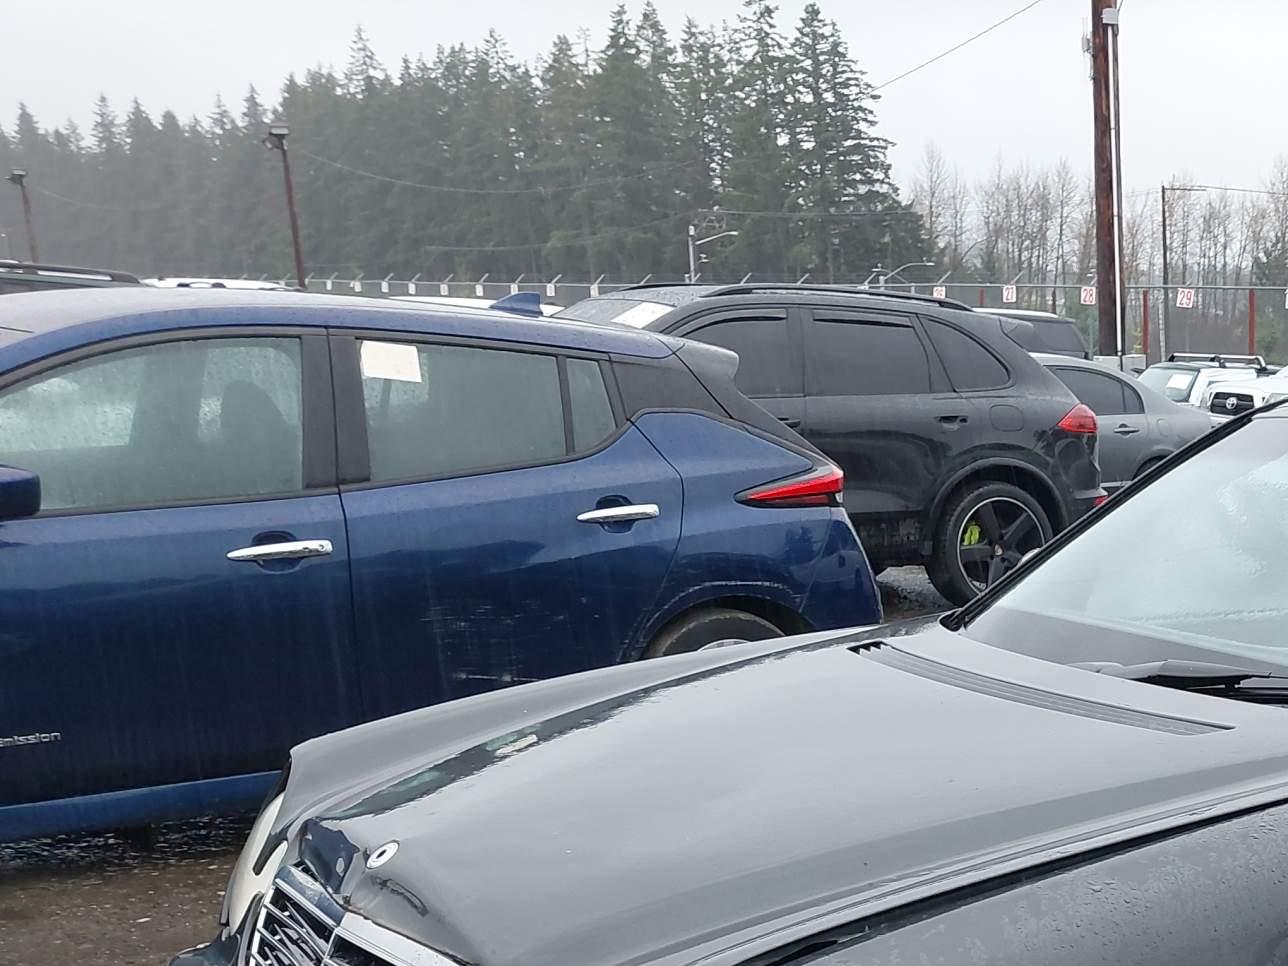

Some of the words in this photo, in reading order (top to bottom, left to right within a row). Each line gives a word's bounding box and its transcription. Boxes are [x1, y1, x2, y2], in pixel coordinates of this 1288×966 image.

[1004, 287, 1015, 301] 27
[1082, 288, 1094, 303] 28
[1179, 290, 1193, 306] 29
